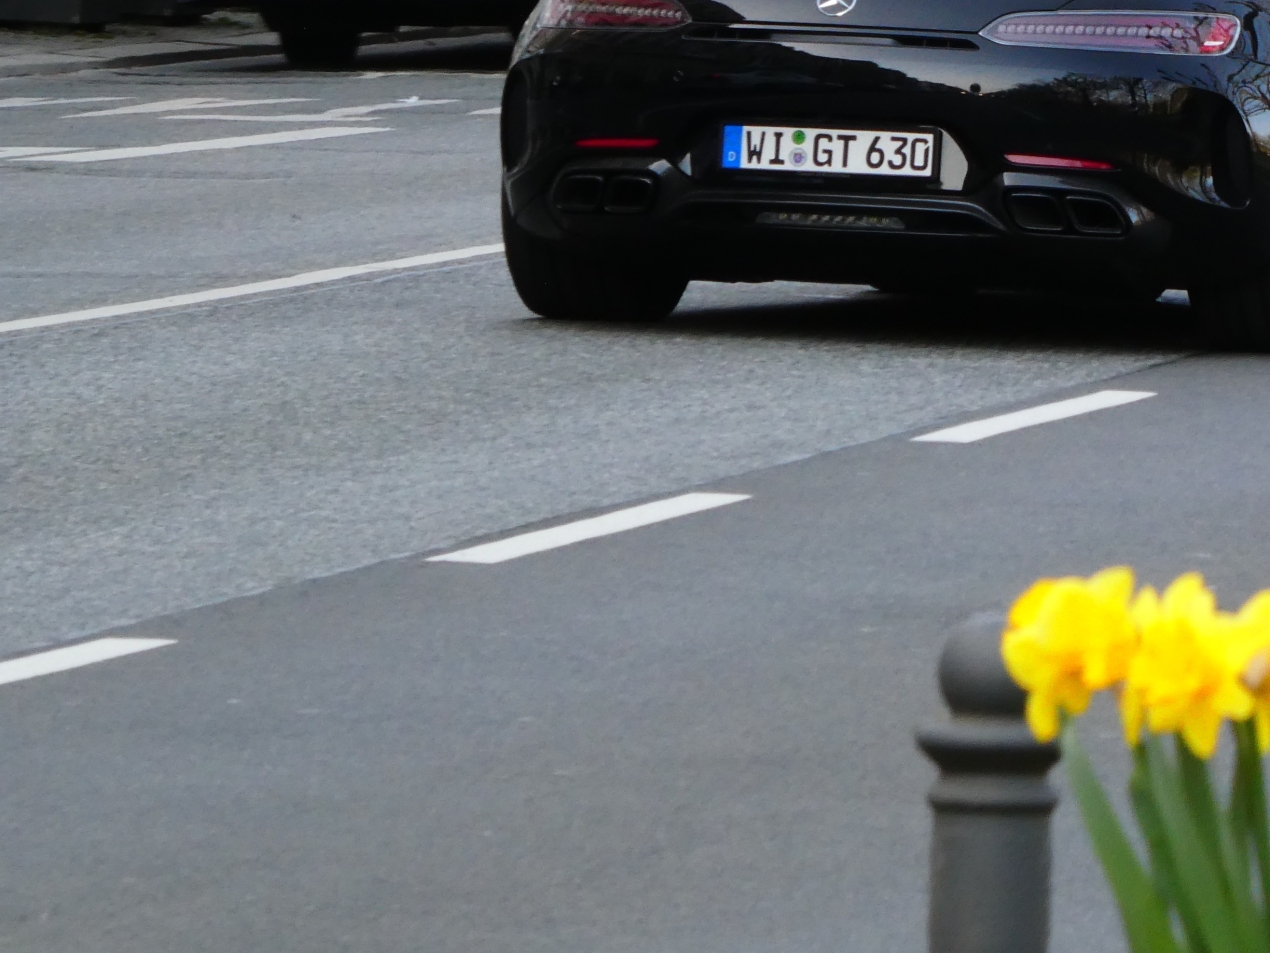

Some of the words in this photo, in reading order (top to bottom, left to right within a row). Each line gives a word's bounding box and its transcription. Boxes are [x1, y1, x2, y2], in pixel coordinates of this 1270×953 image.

[745, 130, 786, 166] WI
[811, 132, 858, 169] GT
[865, 135, 931, 172] 630
